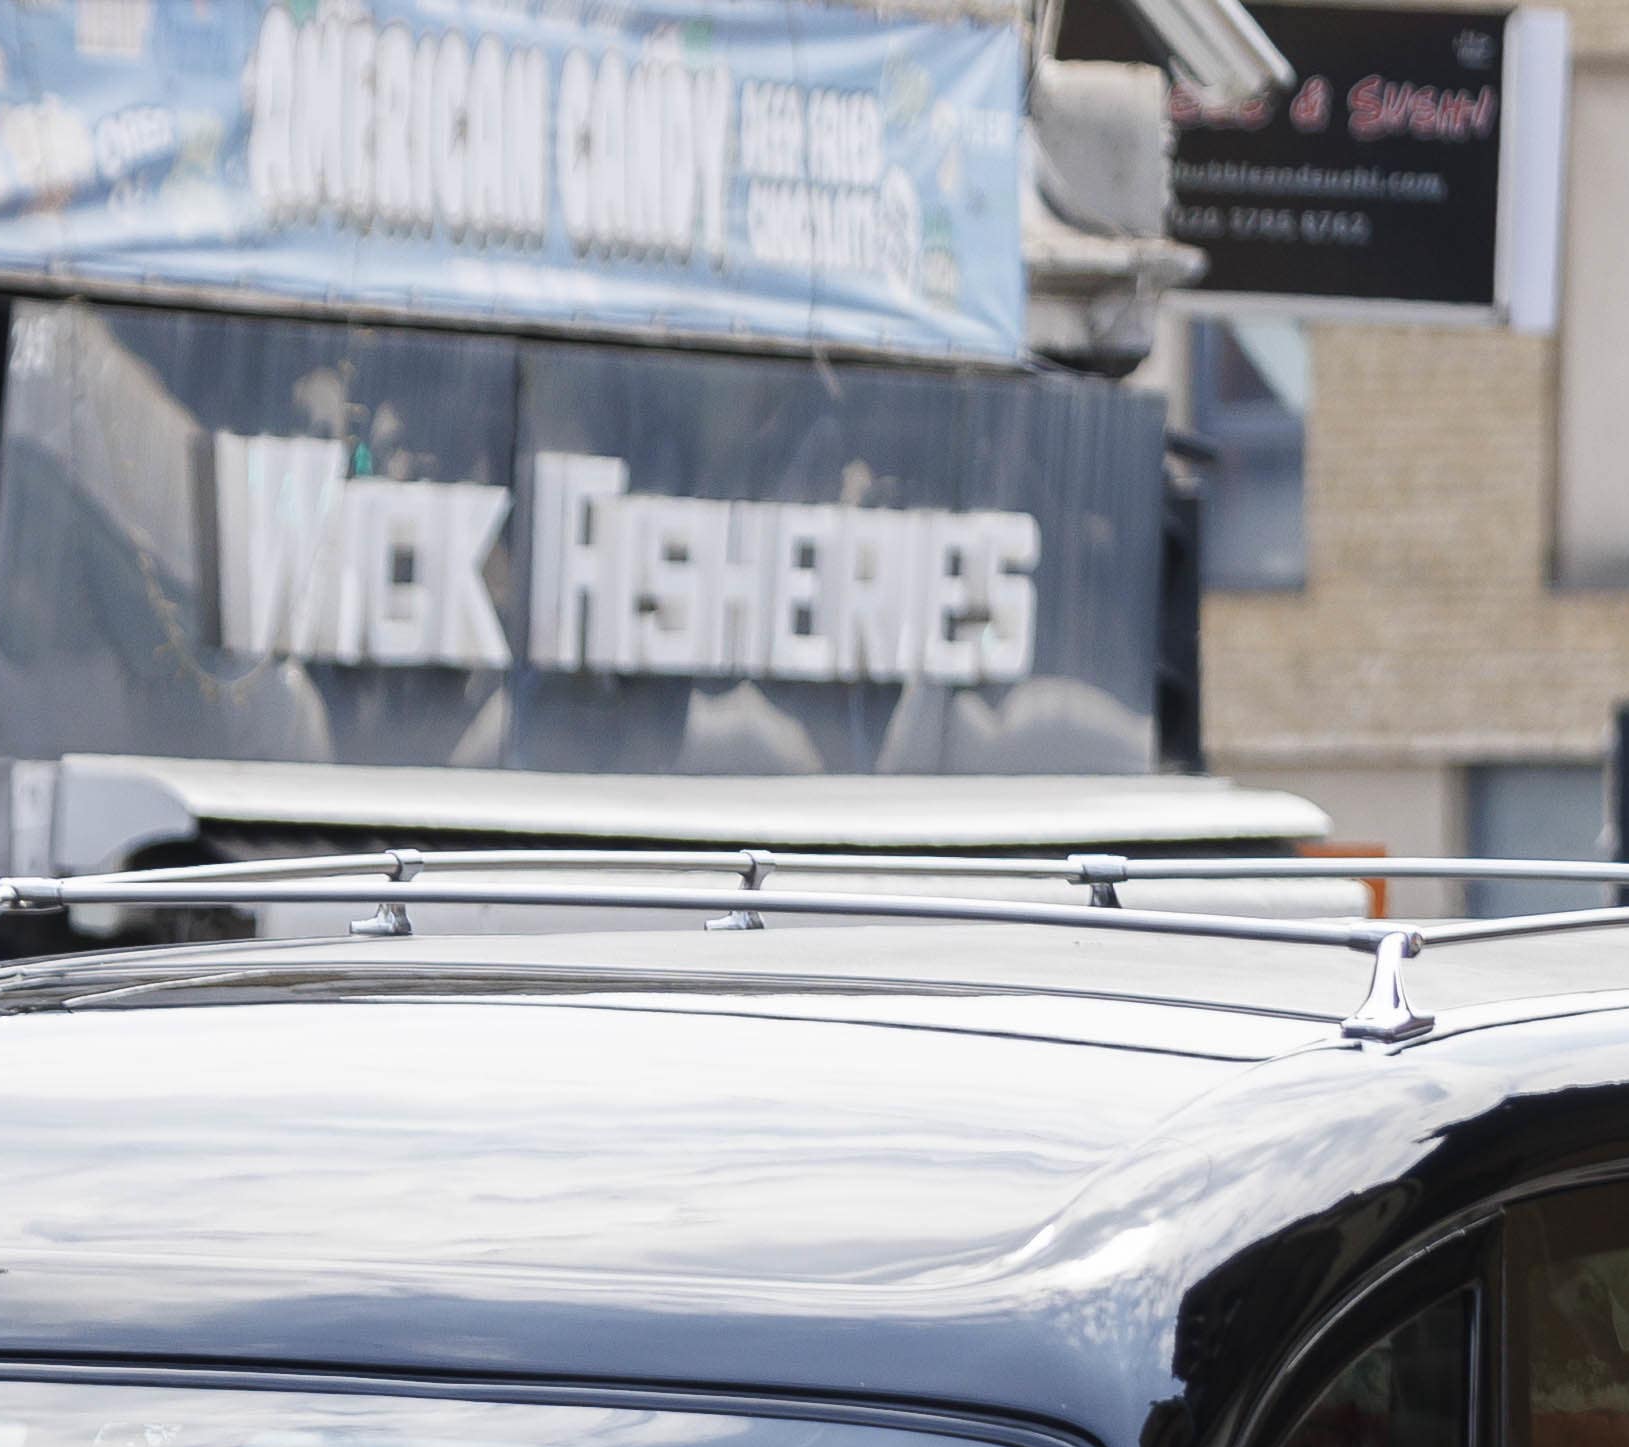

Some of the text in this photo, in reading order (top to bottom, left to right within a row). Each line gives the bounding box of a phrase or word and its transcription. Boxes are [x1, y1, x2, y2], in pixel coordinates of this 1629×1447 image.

[250, 4, 732, 252] AMERICAN CANDY
[1348, 76, 1493, 137] SUSHI
[215, 430, 1042, 683] WICK FISHERIES
